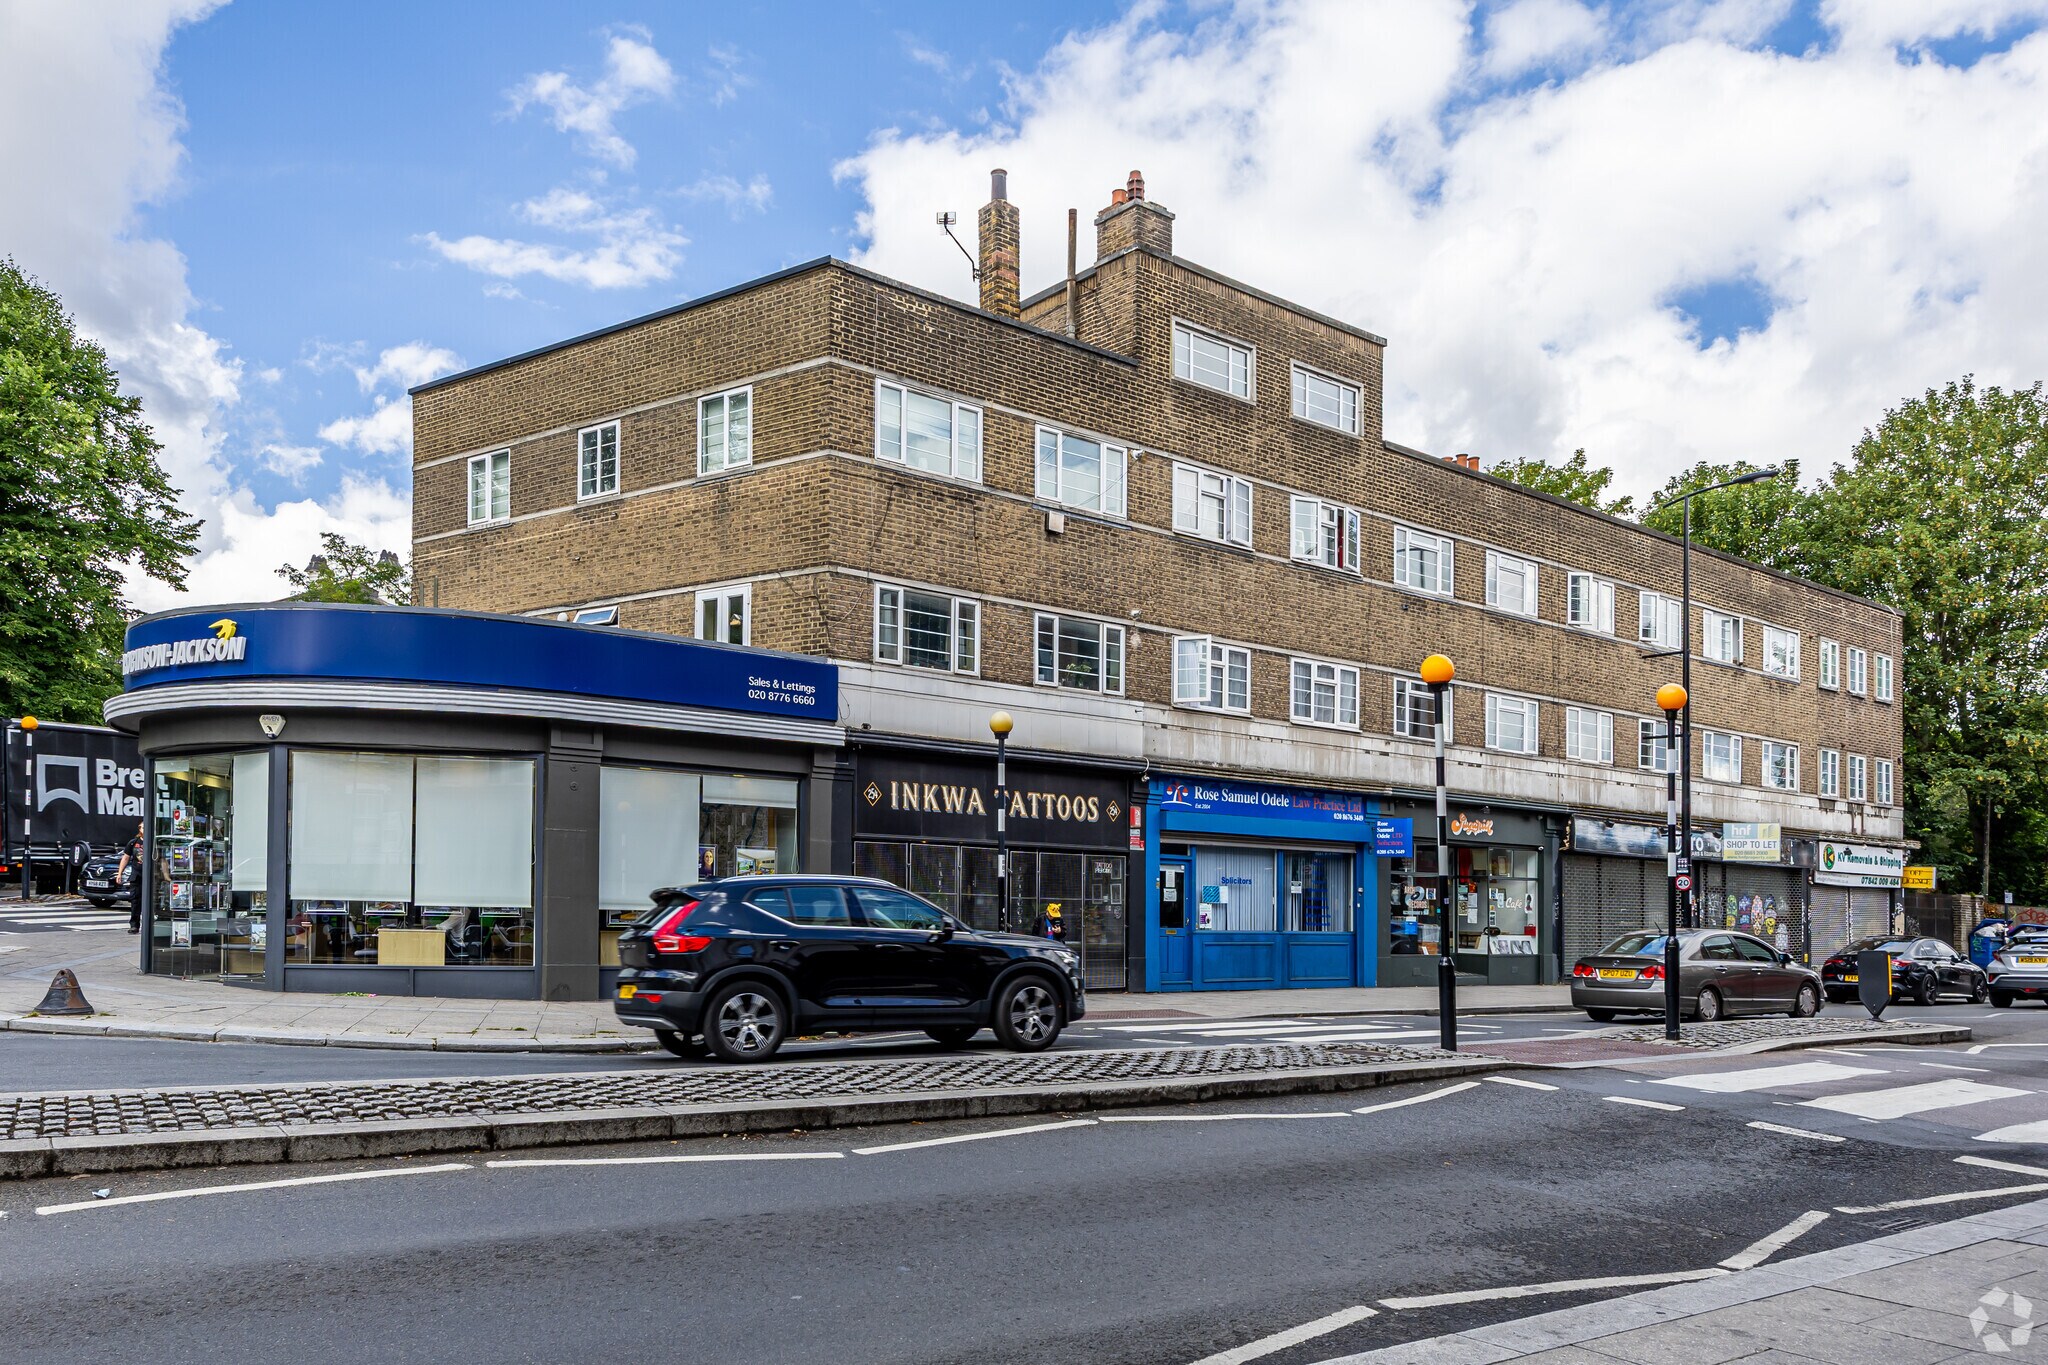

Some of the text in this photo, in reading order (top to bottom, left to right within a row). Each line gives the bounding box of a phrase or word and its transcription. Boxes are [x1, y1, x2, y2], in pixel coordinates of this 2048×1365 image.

[748, 676, 816, 695] Sales & Lettings
[748, 689, 815, 706] 020 8776 6660
[95, 758, 169, 791] Bret
[890, 780, 987, 816] INKWA
[1194, 785, 1362, 813] Rose Samuel Odele Law Practice Ltd
[1333, 812, 1342, 820] 020
[1342, 813, 1353, 821] 8676
[1731, 824, 1752, 836] hnf
[1726, 840, 1778, 849] SHOP TO LET
[1880, 856, 1902, 870] Shipping
[1677, 879, 1690, 887] 20
[1860, 877, 1878, 885] 07842
[1878, 878, 1889, 886] 009
[1505, 897, 1523, 911] Café
